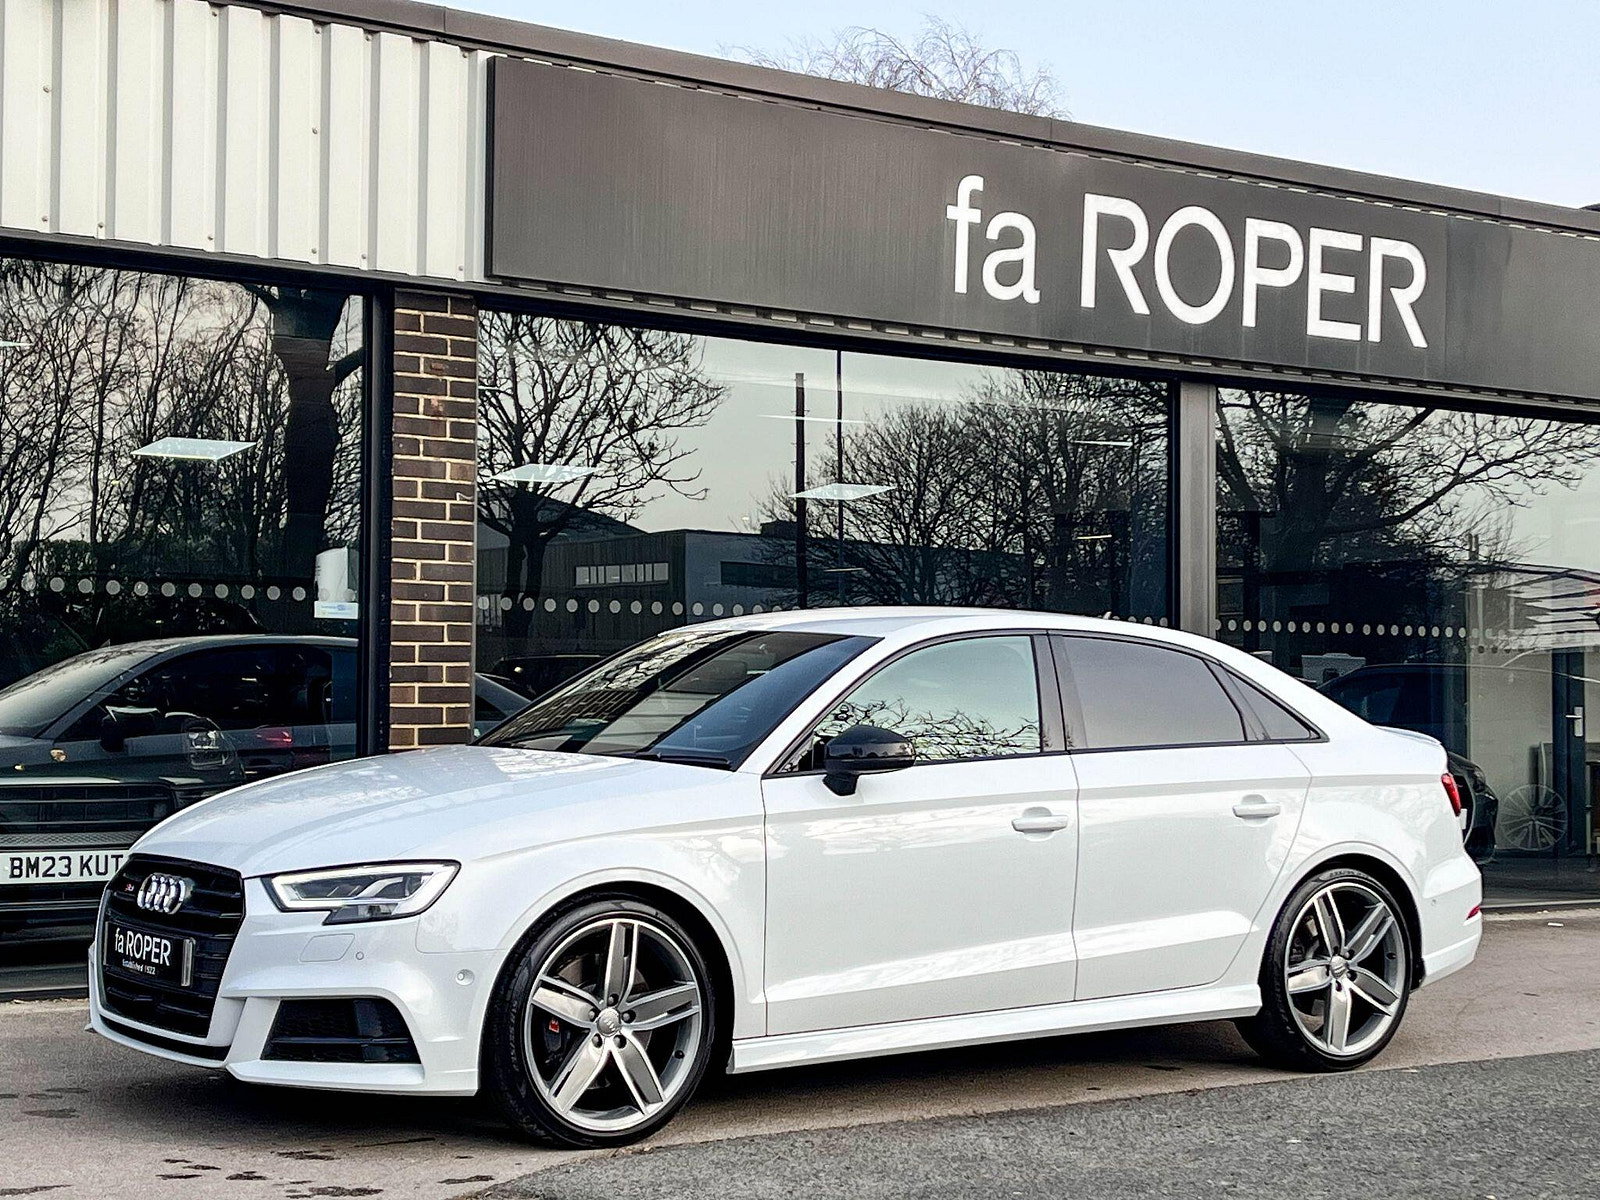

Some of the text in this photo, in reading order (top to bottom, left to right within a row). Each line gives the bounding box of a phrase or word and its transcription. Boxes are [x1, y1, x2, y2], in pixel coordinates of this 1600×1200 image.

[946, 175, 1428, 349] fa ROPER
[9, 854, 124, 879] BM23 KUT
[115, 927, 171, 967] fa ROPER
